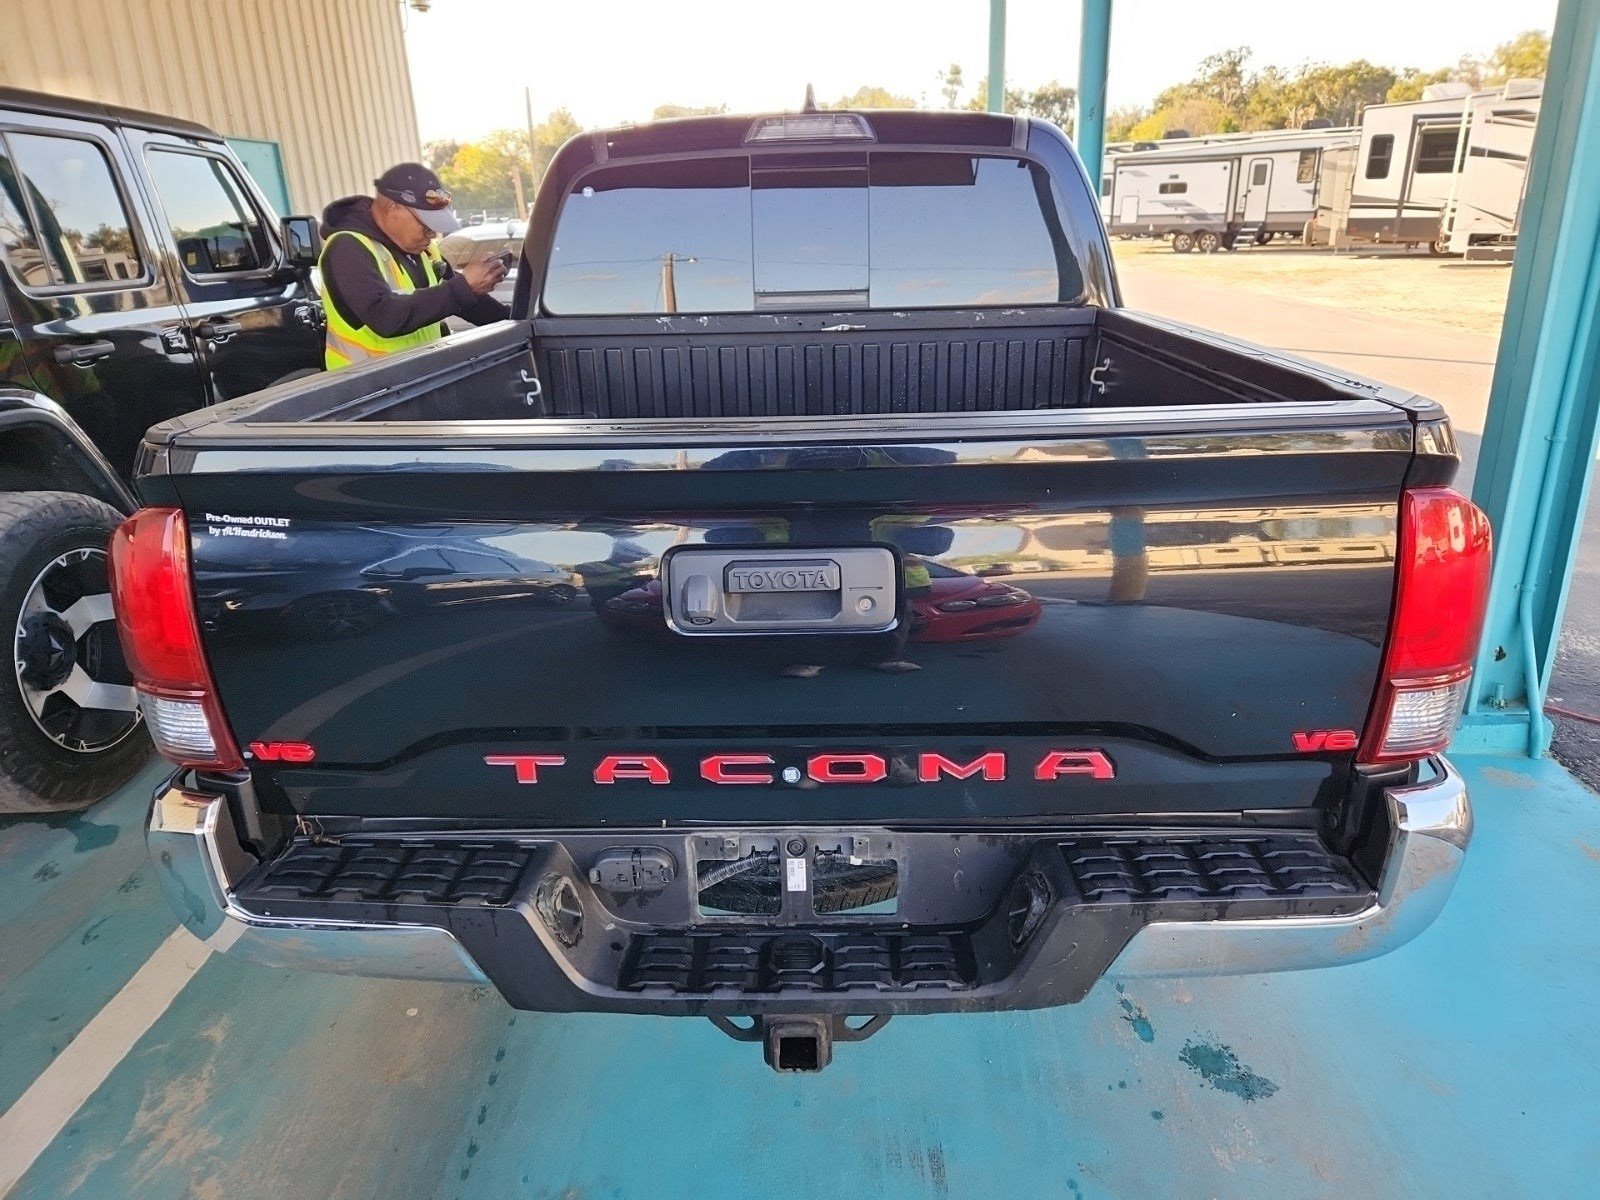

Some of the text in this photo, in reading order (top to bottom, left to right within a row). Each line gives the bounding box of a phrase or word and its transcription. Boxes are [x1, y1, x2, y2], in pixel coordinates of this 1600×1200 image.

[205, 513, 290, 527] Pre-Owned OUTLET
[208, 526, 221, 537] by
[732, 570, 832, 590] TOYOTA
[1291, 729, 1357, 753] V6
[249, 741, 316, 763] V6
[483, 749, 1116, 785] TACOMA
